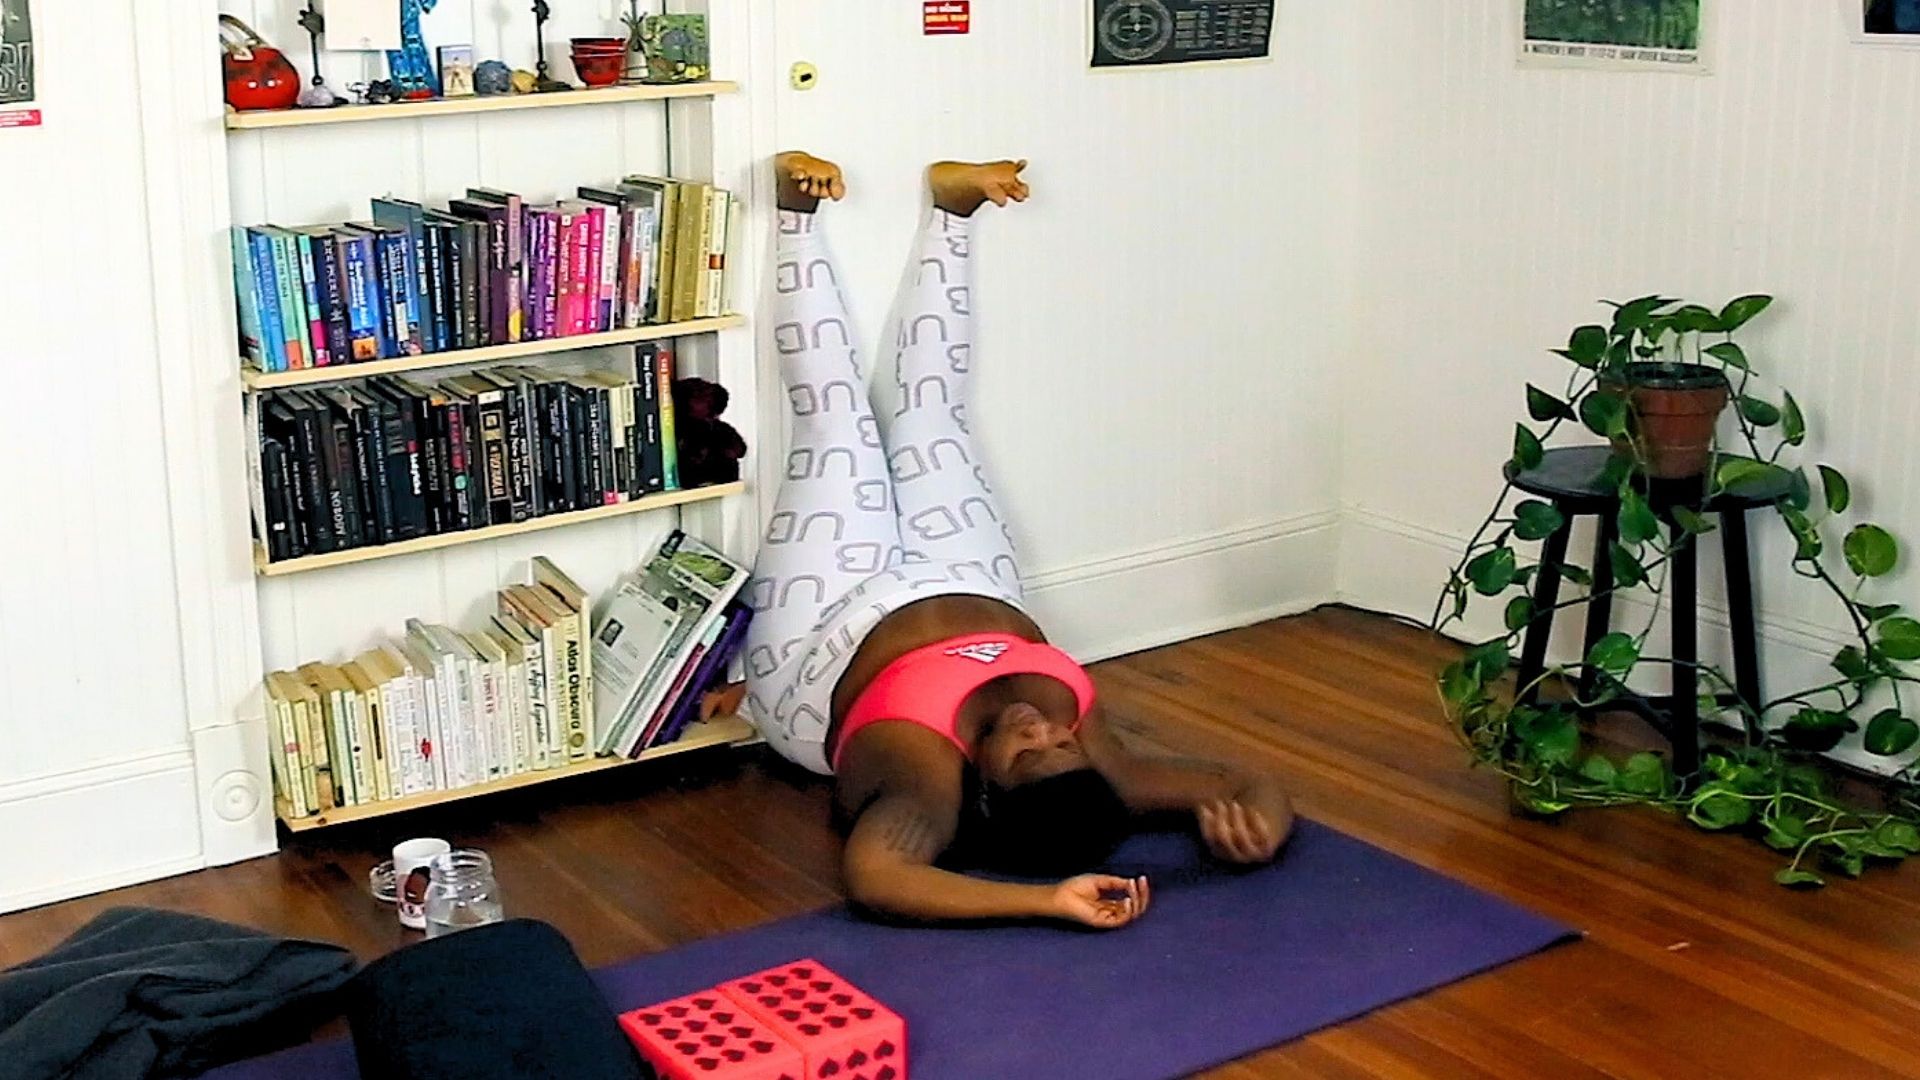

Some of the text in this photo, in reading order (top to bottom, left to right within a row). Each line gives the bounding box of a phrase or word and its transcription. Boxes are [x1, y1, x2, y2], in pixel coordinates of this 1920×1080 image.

[330, 490, 346, 535] NOBODY
[567, 640, 581, 730] Atlas Obscura
